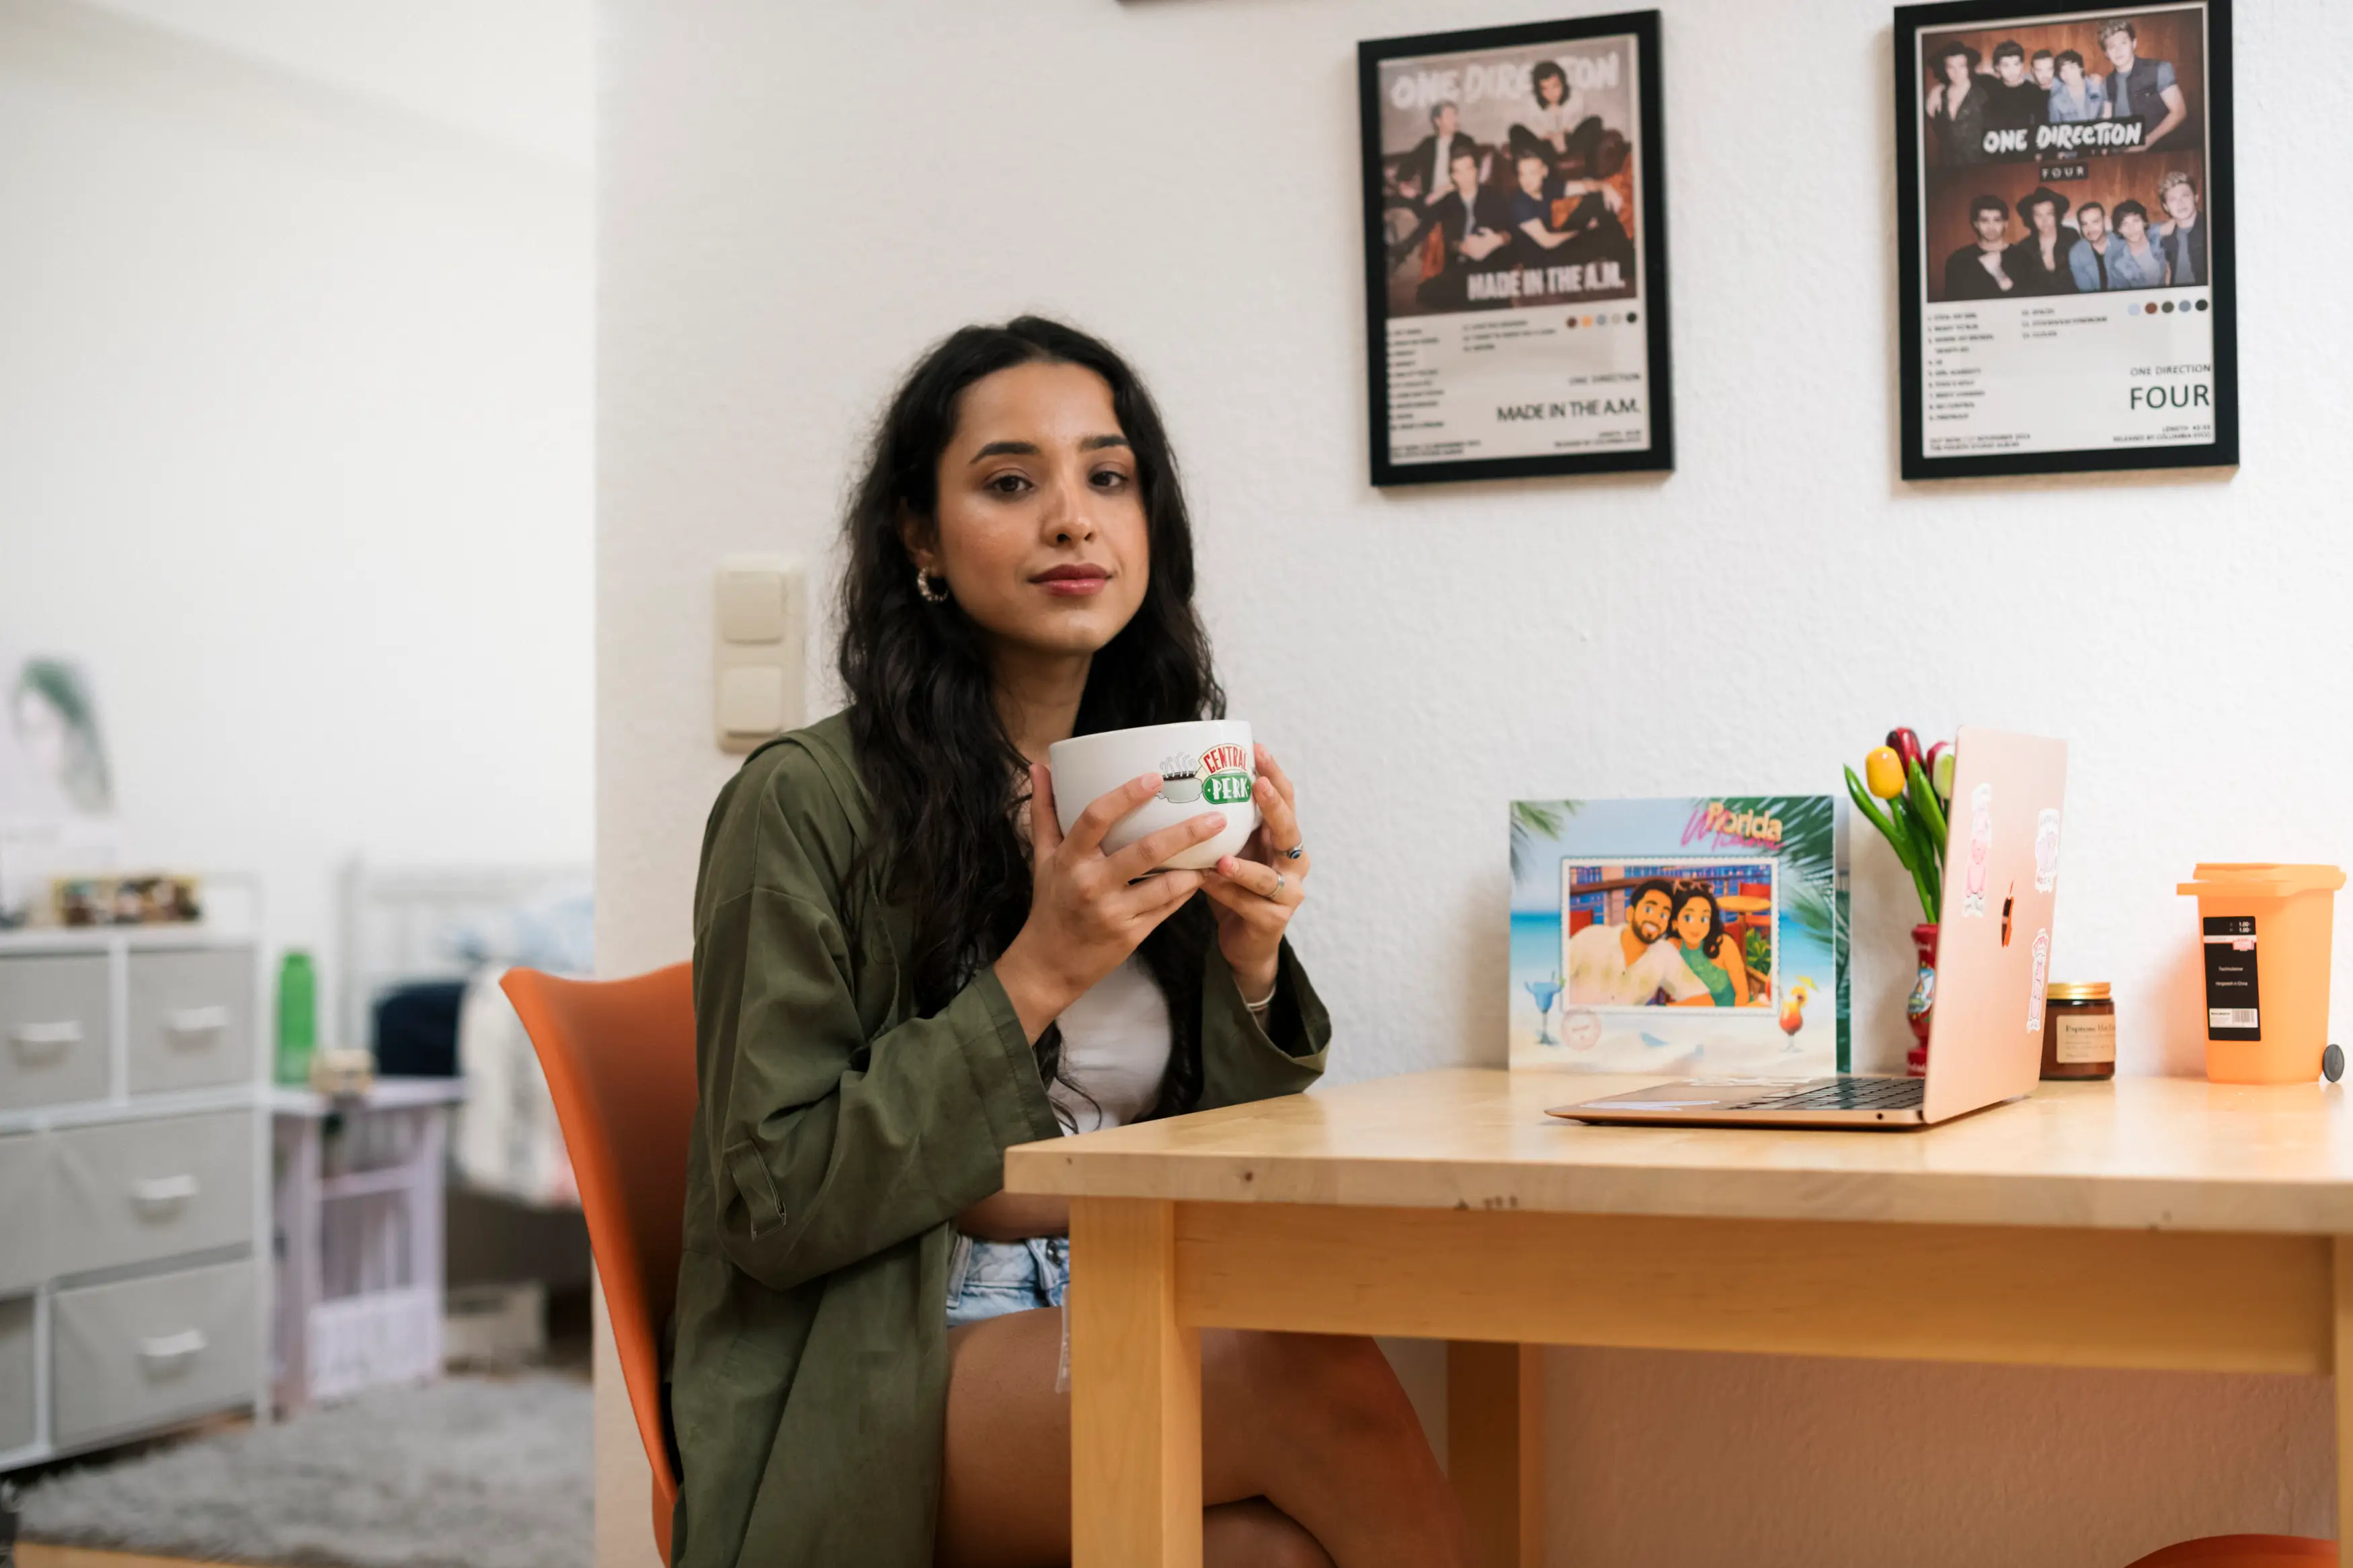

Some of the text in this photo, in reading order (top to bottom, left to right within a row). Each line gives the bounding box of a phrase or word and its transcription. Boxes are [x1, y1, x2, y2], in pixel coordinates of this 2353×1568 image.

[1390, 69, 1460, 109] ONE
[1983, 122, 2143, 154] ONE DIRECTION
[2041, 165, 2084, 179] FOUR
[1467, 271, 1521, 300] MADE
[1523, 268, 1544, 296] IN
[1547, 265, 1582, 294] THE
[2130, 364, 2210, 376] ONE DIRECTION
[1497, 398, 1640, 422] MADE IN THE A.M.
[2130, 384, 2210, 410] FOUR
[1203, 746, 1248, 774] CENTRAL
[1211, 777, 1249, 800] PERK
[1706, 802, 1783, 842] Florida
